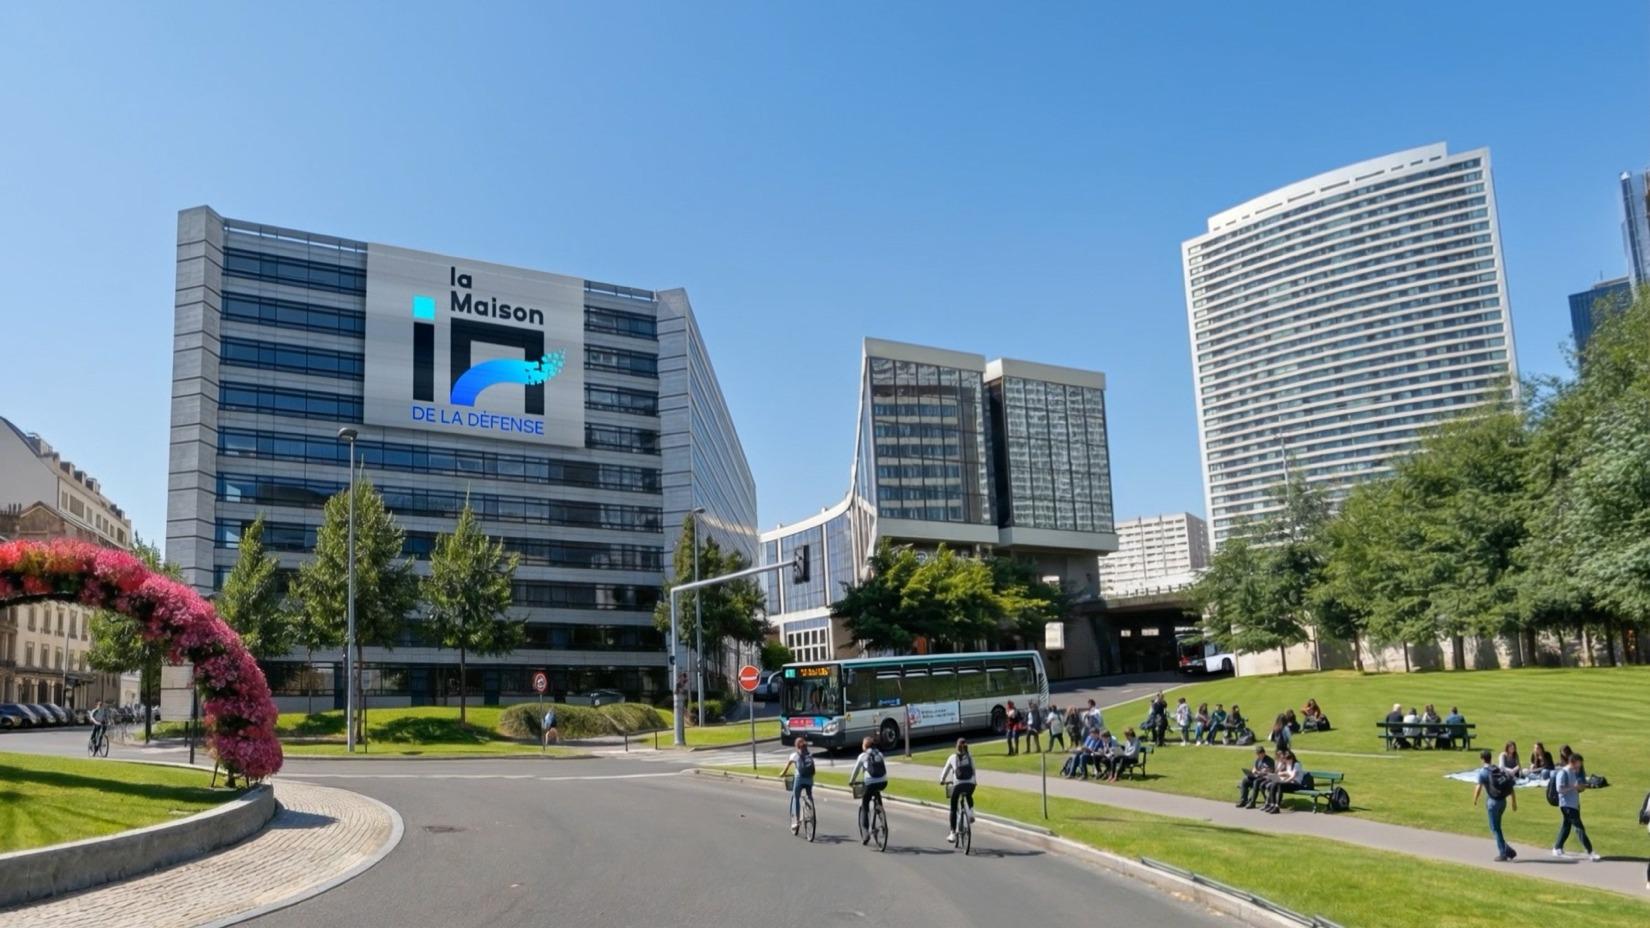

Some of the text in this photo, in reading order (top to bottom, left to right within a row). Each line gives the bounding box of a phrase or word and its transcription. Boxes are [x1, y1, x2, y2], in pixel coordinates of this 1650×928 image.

[451, 266, 472, 289] la
[451, 290, 544, 325] Maison
[412, 406, 544, 435] DE LA DÉFENSE
